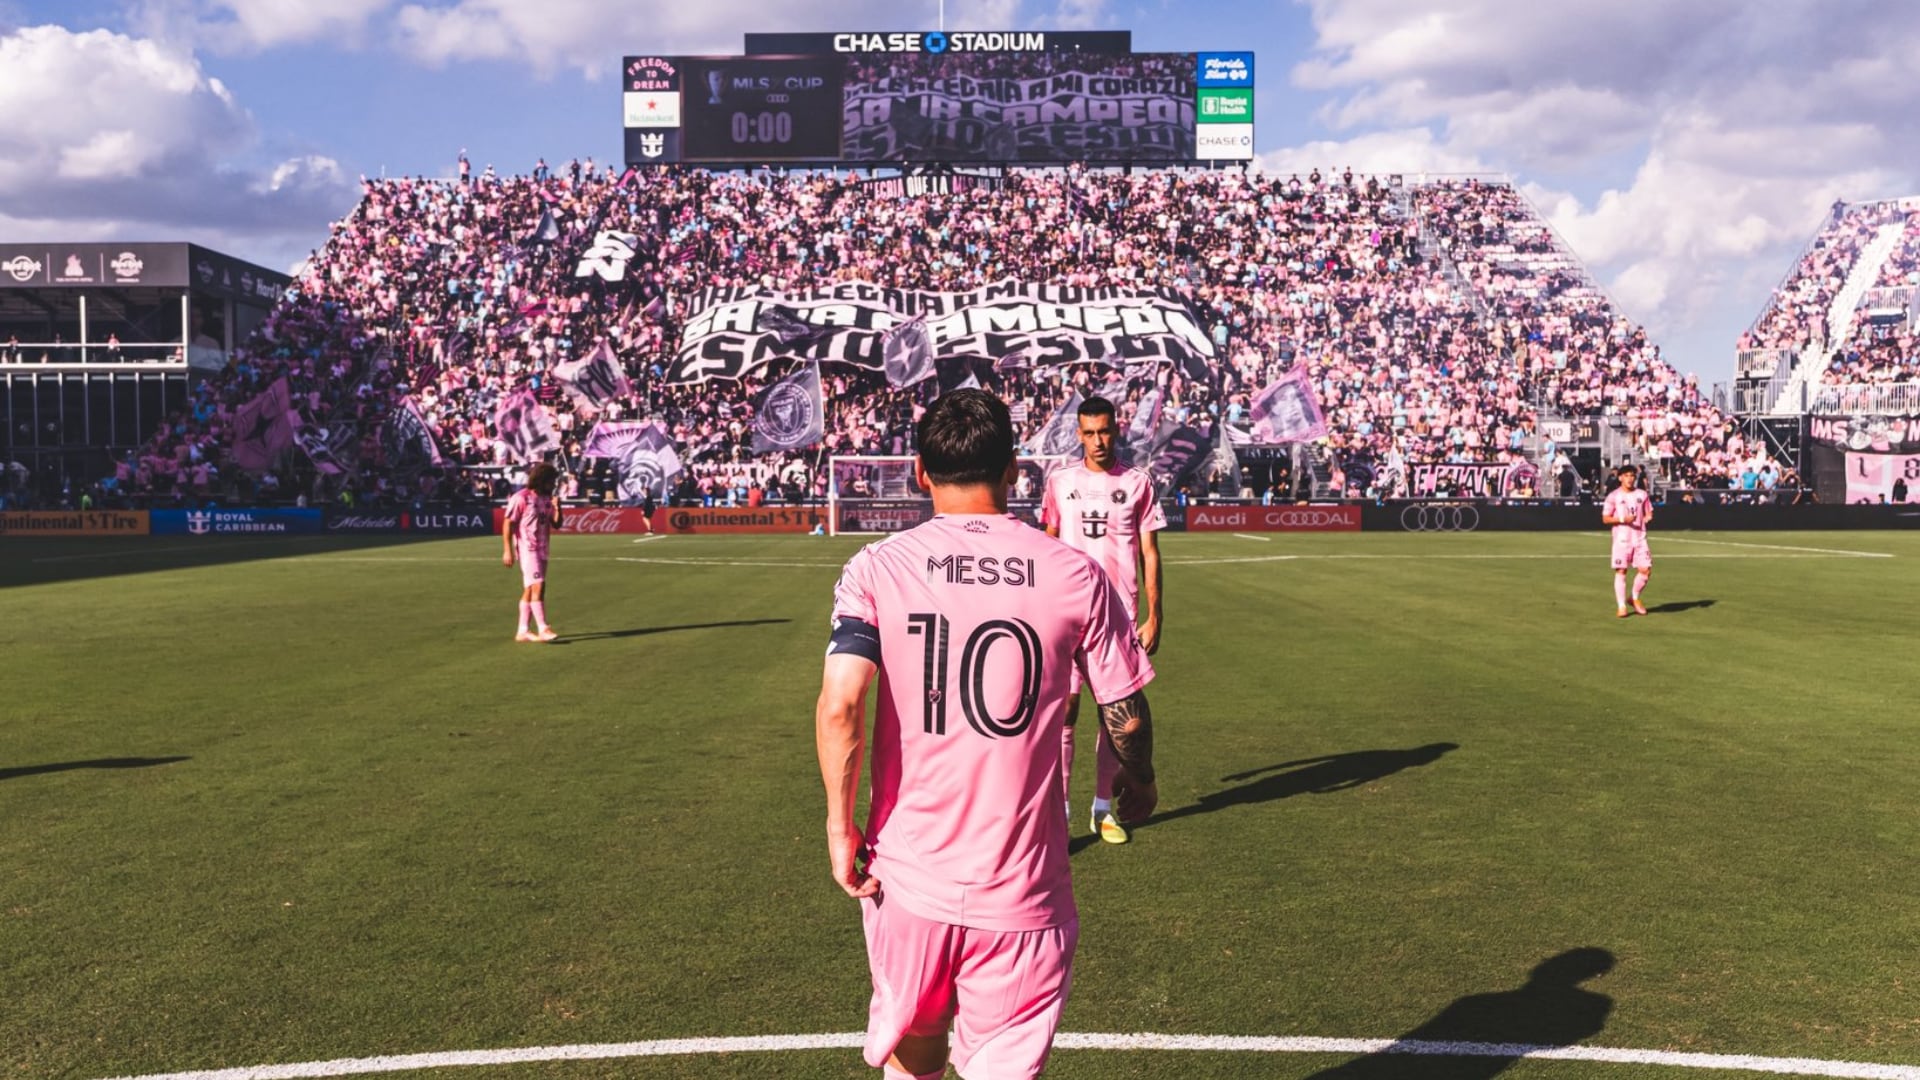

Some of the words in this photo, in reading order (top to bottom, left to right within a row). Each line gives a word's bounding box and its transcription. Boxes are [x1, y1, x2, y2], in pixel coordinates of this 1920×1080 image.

[833, 34, 921, 52] CHASE
[950, 33, 1044, 51] STADIUM
[627, 57, 676, 76] FREEDOM
[633, 81, 669, 89] DREAM
[734, 77, 770, 89] MLS
[784, 77, 823, 88] CUP
[732, 112, 792, 143] 0:00
[1199, 136, 1237, 145] CHASE
[101, 512, 138, 529] Tire
[215, 513, 253, 522] ROYAL
[416, 515, 484, 527] ULTRA
[670, 511, 774, 530] Continental
[1194, 513, 1246, 525] Audi
[215, 523, 285, 532] CARIBBEAN
[926, 554, 1035, 587] MESSI
[907, 613, 1044, 740] 10
